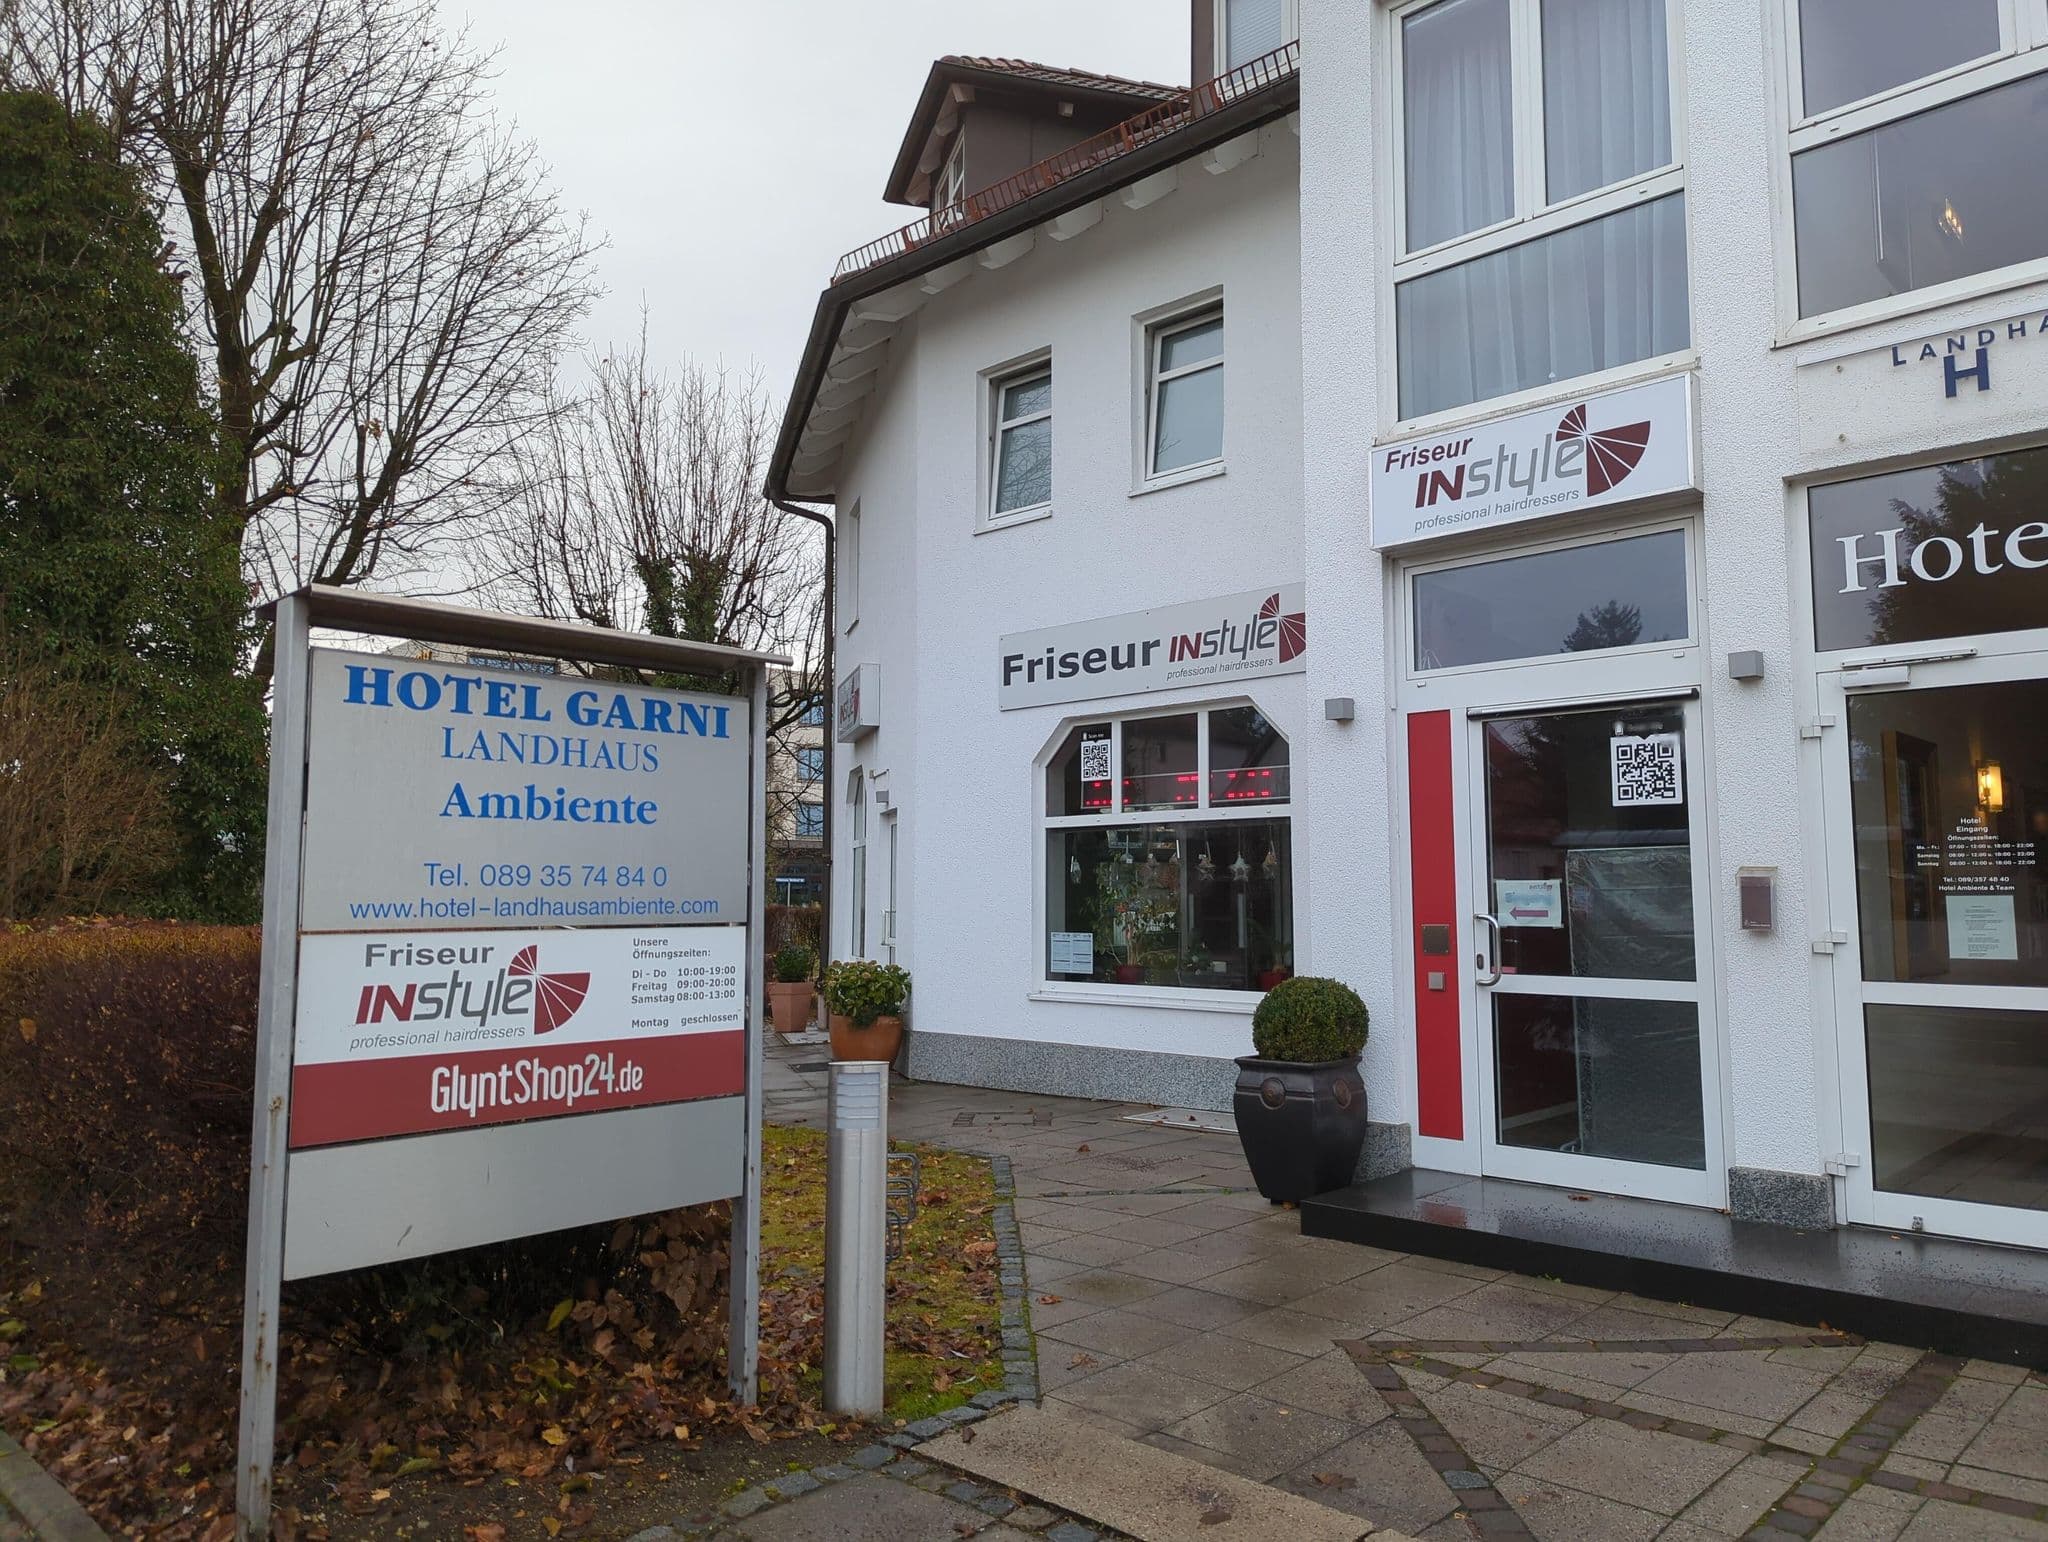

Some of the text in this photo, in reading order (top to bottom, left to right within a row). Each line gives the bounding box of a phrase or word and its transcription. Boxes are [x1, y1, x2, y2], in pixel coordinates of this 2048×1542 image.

[1943, 347, 1991, 398] H
[1385, 437, 1473, 473] Friseur
[1415, 433, 1585, 509] INstyle
[1414, 488, 1579, 533] professional hairdressers
[1003, 614, 1278, 687] Friseur INstyle
[1167, 658, 1274, 681] professional hairdressers
[343, 665, 730, 739] HOTEL GARNI
[441, 727, 659, 773] LANDHAUS
[439, 783, 658, 825] Ambiente
[424, 863, 667, 888] Tel. 089 35 74 84 0
[350, 896, 719, 919] www.hotel-landhausambiente.com
[365, 943, 494, 967] Friseur
[633, 938, 668, 947] Unsere
[633, 949, 711, 960] Öffnungszeiten:
[632, 970, 643, 979] Di
[654, 969, 667, 978] Do
[678, 966, 736, 977] 10:00-19:00
[632, 978, 736, 992] Freitag 09:00-20:00
[355, 969, 533, 1026] INstyle
[632, 995, 675, 1004] Samstag
[632, 1014, 738, 1028] Montag geschlossen
[350, 1026, 525, 1052] professional hairdressers
[431, 1052, 643, 1118] GlyntShop24.de
